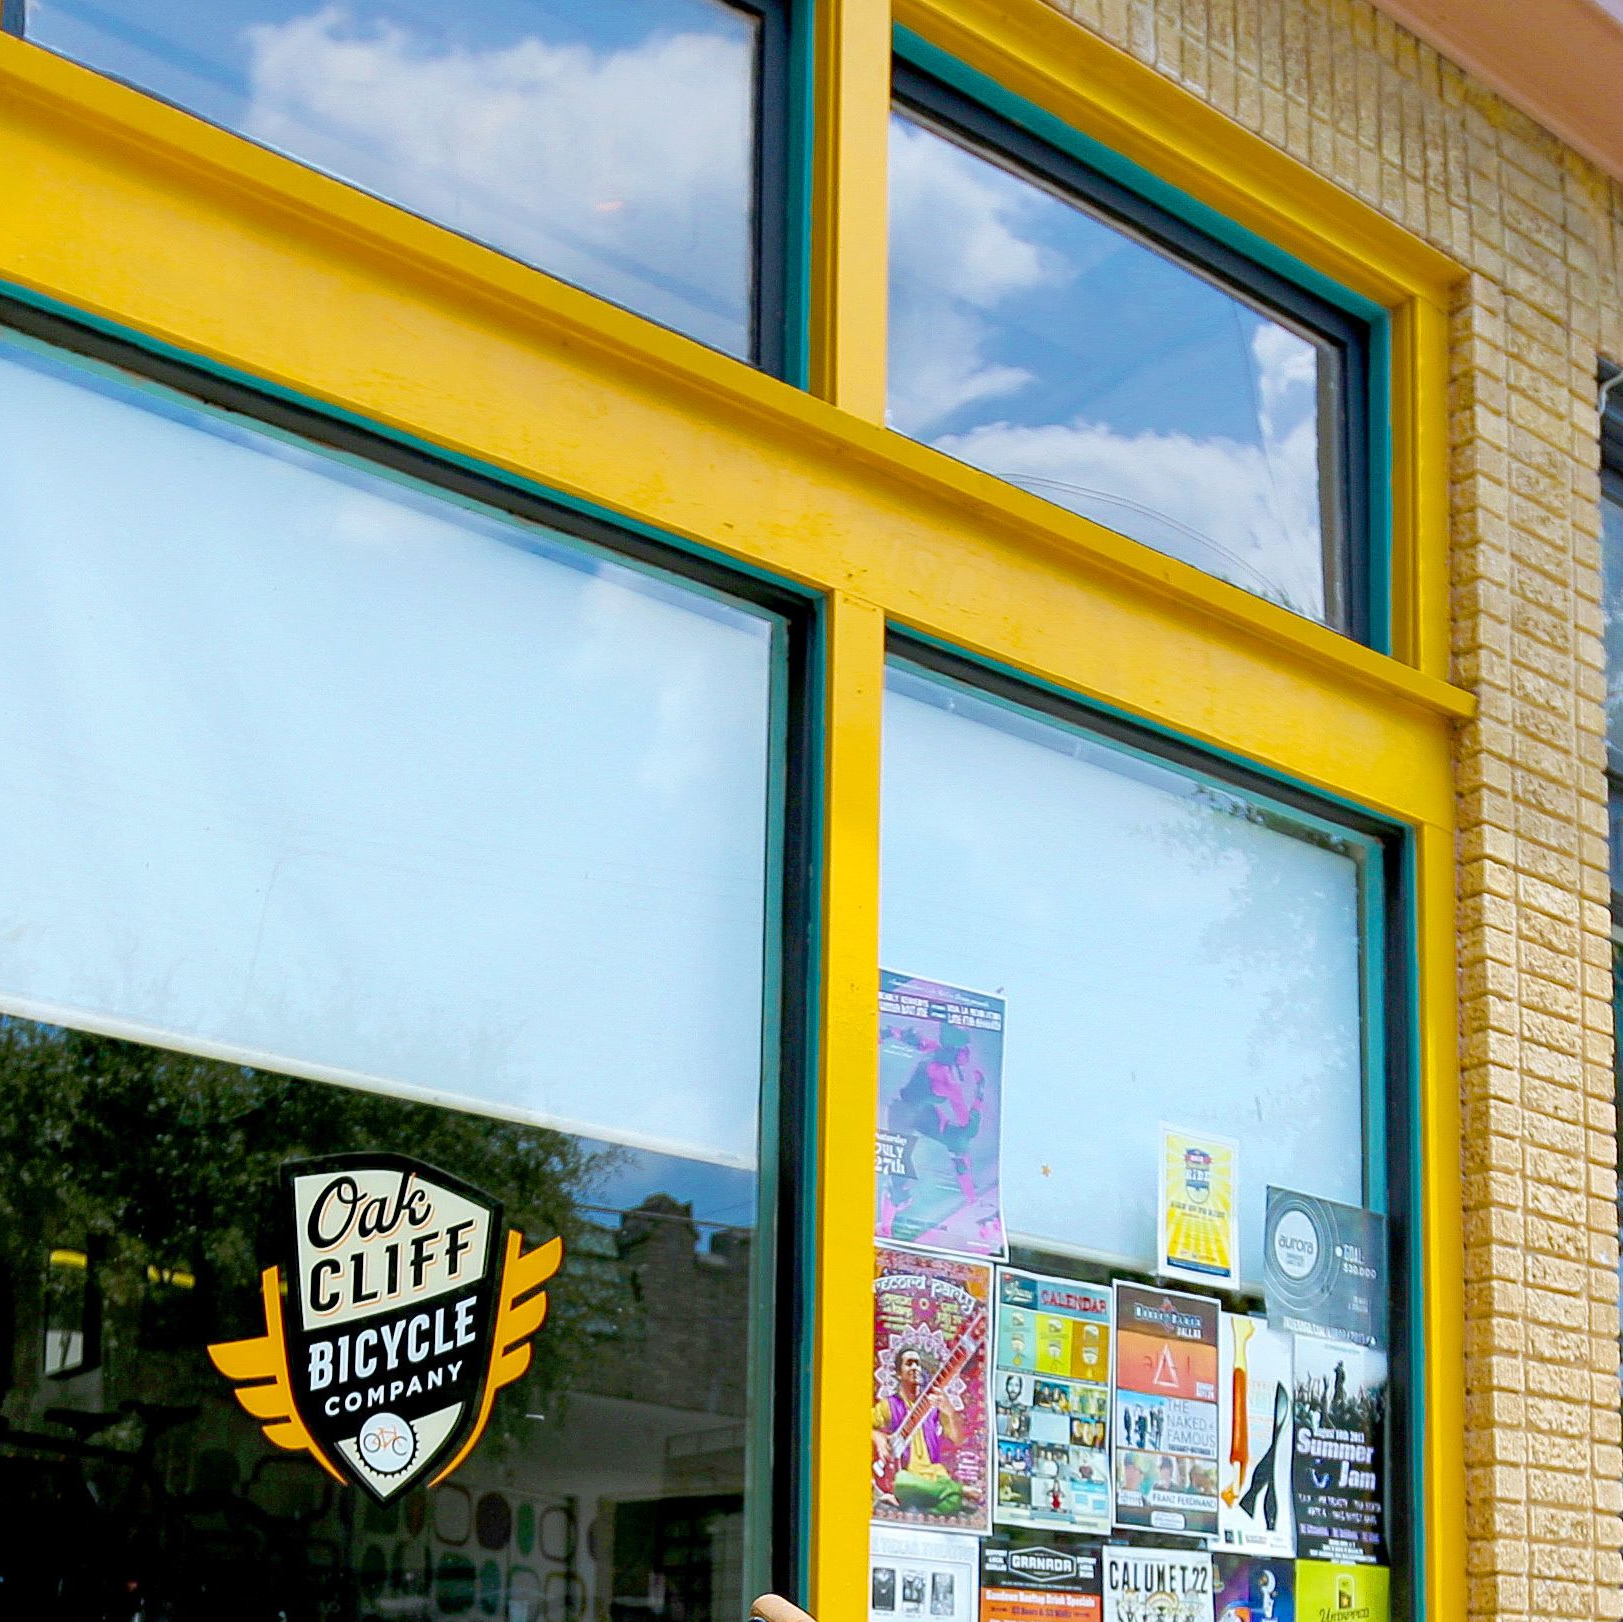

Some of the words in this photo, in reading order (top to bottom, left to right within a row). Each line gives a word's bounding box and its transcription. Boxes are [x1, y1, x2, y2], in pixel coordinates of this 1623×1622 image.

[307, 1172, 432, 1249] Oak
[1278, 1233, 1315, 1256] aurora
[309, 1218, 476, 1314] CLIFF
[1041, 1289, 1108, 1315] CALENDAR
[308, 1295, 478, 1392] BICYCLE
[324, 1360, 464, 1417] COMPANY
[1167, 1414, 1207, 1431] NAKED
[1167, 1429, 1216, 1448] FAMOUS
[1296, 1427, 1374, 1464] Summer
[1338, 1460, 1376, 1490] Jam
[1012, 1555, 1072, 1572] GRANADA
[1109, 1560, 1187, 1592] CALUMET
[1191, 1566, 1208, 1594] 22
